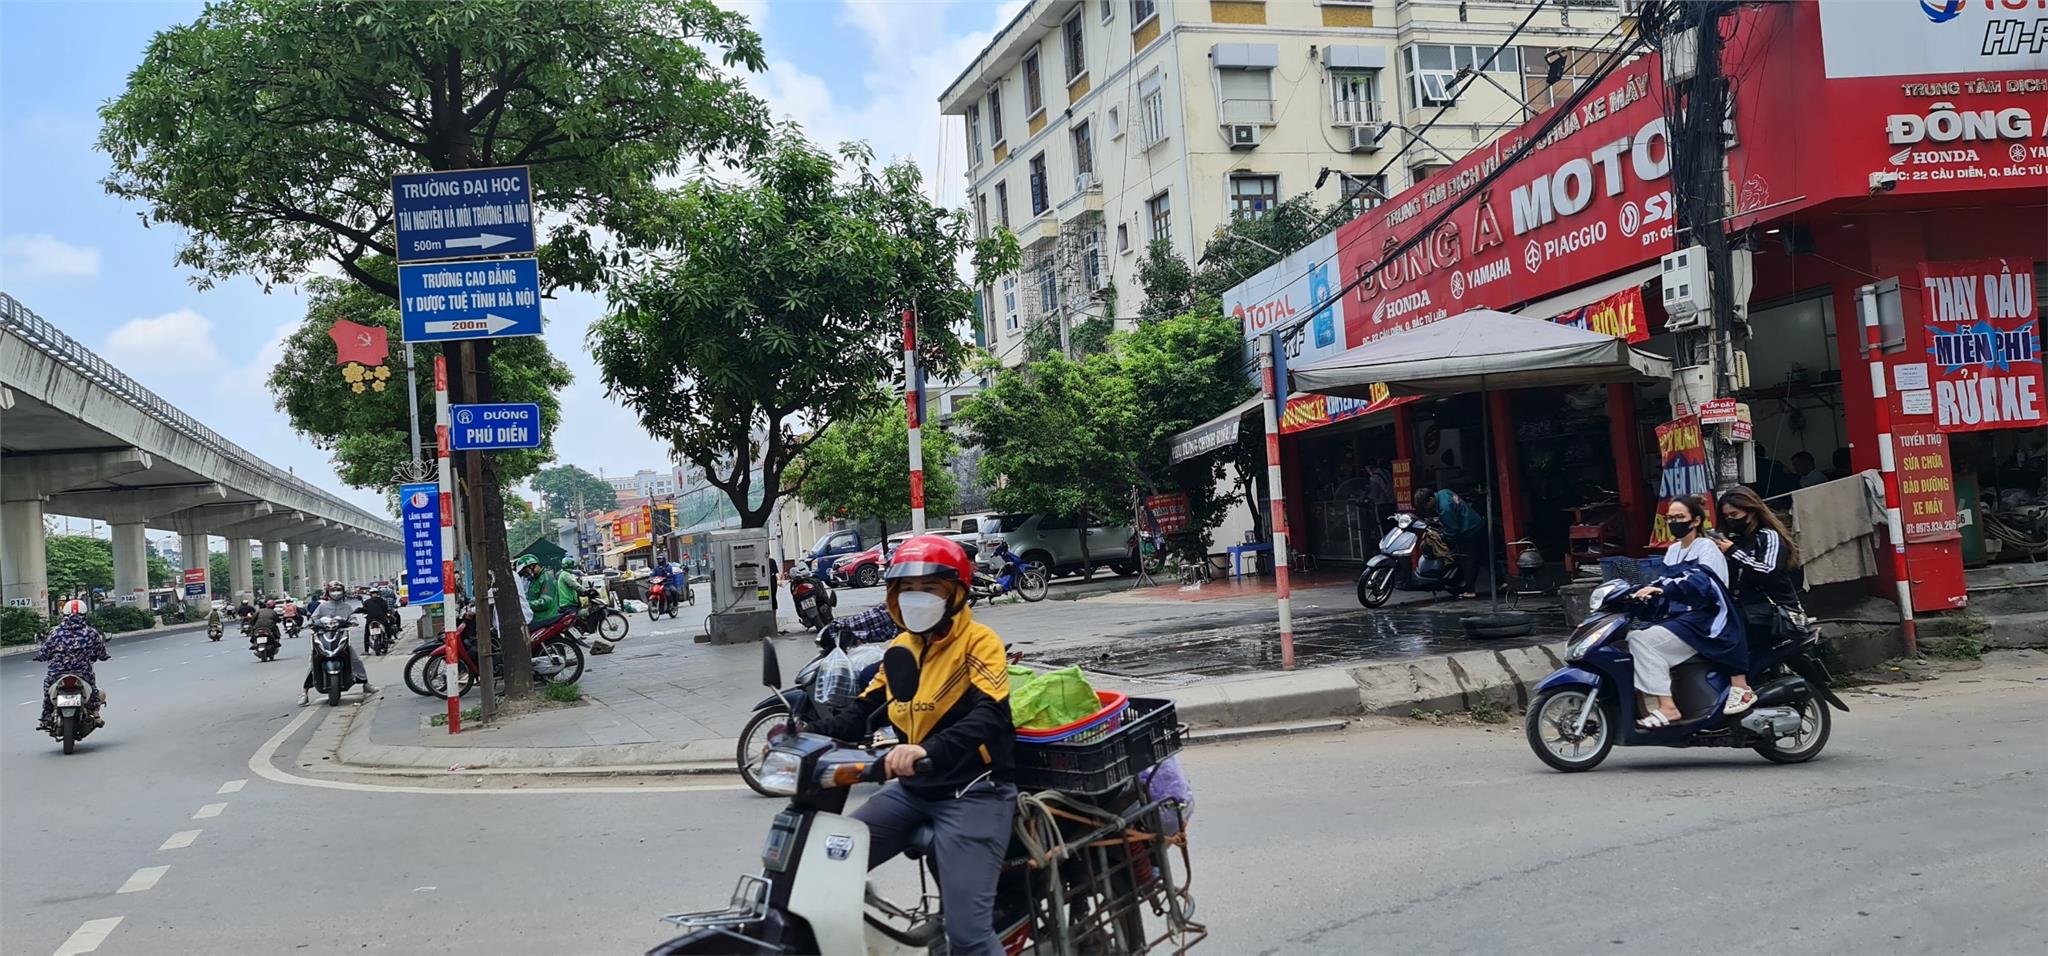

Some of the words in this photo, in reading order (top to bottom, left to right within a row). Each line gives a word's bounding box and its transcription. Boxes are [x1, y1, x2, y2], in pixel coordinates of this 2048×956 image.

[1902, 82, 1960, 97] TRUNG
[1965, 78, 2002, 93] TÂM
[1886, 102, 2032, 145] ĐÔNG
[1385, 198, 1421, 228] TRUNG
[1582, 96, 1607, 127] XE
[1609, 75, 1649, 113] MÁY
[1912, 150, 1980, 165] HONDA
[1912, 171, 1928, 181] 22
[1931, 167, 1954, 180] CẦU
[1957, 166, 1987, 179] DIỄN,
[1989, 168, 2000, 178] Q.
[401, 178, 460, 199] TRƯỜNG
[463, 178, 488, 198] ĐẠI
[491, 176, 520, 196] HỌC
[1471, 188, 1504, 255] Á
[1510, 116, 1674, 236] MOTO
[399, 207, 412, 231] TÀI
[412, 205, 444, 231] NGUYÊN
[444, 204, 456, 228] VÀ
[456, 203, 472, 228] MÔI
[472, 200, 503, 227] TRƯỜNG
[503, 200, 515, 225] HÀ
[515, 199, 529, 228] NỘI
[414, 239, 442, 252] 500m
[1544, 220, 1607, 261] PIAGGIO
[422, 268, 463, 289] TRƯỜNG
[465, 271, 486, 287] CAO
[488, 262, 517, 286] ĐẲNG
[1386, 289, 1431, 319] HONDA
[1467, 257, 1512, 289] YAMAHA
[1924, 275, 1977, 322] THAY
[406, 297, 413, 313] Y
[416, 294, 446, 315] DƯỢC
[448, 290, 469, 312] TUỆ
[470, 290, 496, 309] TĨNH
[498, 288, 514, 307] HÀ
[516, 287, 535, 309] NỘI
[1247, 295, 1295, 331] TOTAL
[1934, 325, 1993, 366] MIỄN
[1994, 326, 2033, 362] PHÍ
[484, 410, 528, 420] ĐƯỜNG
[1702, 407, 1735, 415] INTERNET
[466, 425, 493, 444] PHÚ
[497, 422, 528, 443] DIỄN
[1903, 452, 1920, 471] SỬA
[1921, 452, 1944, 470] CHỮA
[1903, 475, 1919, 494] BẢO
[1921, 475, 1949, 492] DƯỠNG
[1913, 501, 1924, 515] XE
[1925, 496, 1943, 514] MÁY
[11, 599, 31, 607] P147
